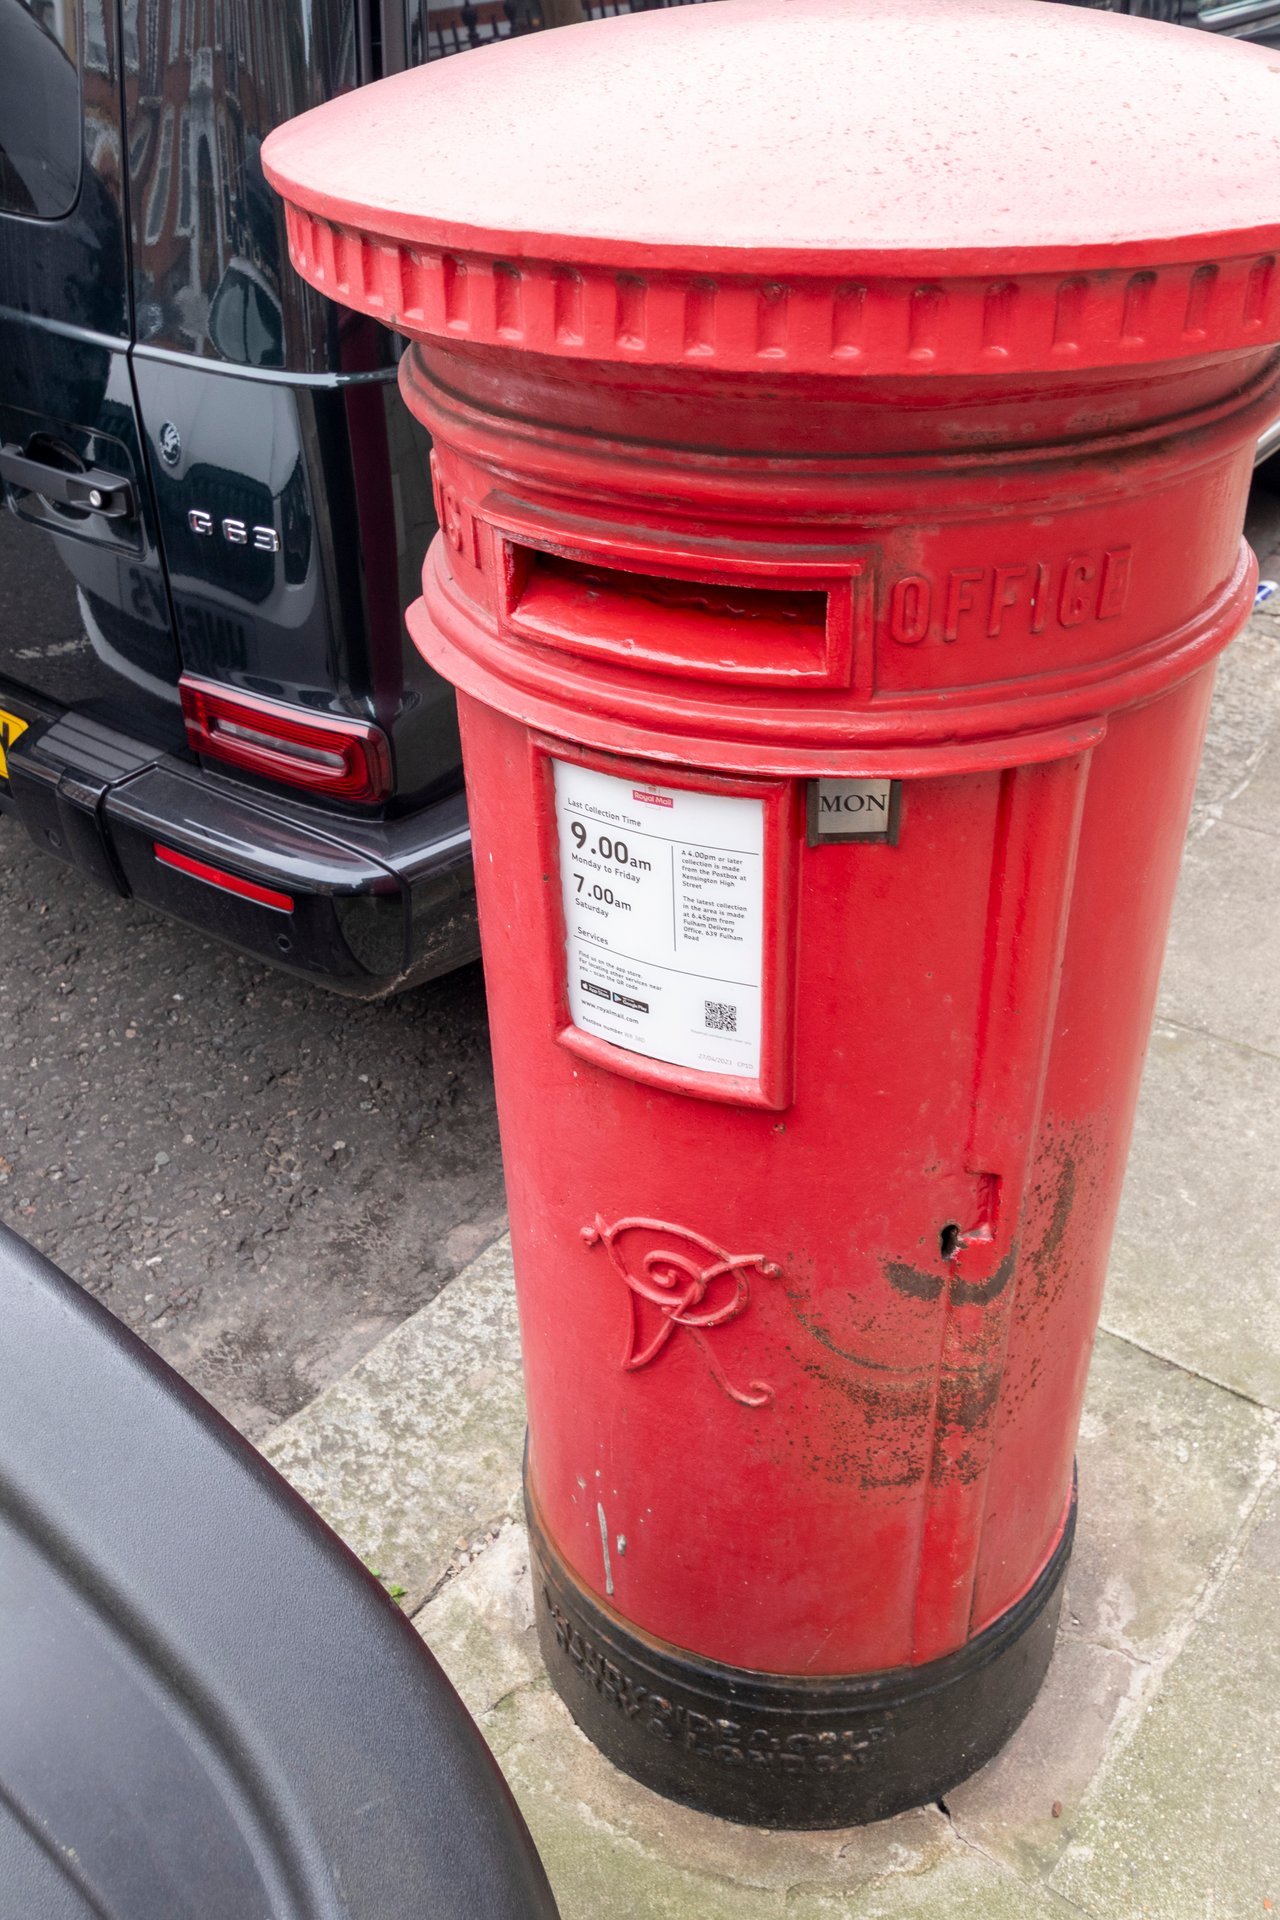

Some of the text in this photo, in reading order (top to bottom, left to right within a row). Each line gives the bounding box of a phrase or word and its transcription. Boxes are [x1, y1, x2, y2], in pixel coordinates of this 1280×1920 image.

[188, 509, 279, 552] G 63
[889, 542, 1133, 645] OFFICE
[634, 791, 672, 806] Royal Mail
[819, 793, 888, 813] MON
[568, 797, 641, 827] Last Collection Time
[571, 821, 652, 872] 9.00am
[682, 858, 712, 868] collection
[688, 851, 716, 861] 4.00pm
[727, 857, 743, 865] later
[571, 852, 641, 884] Monday to Friday
[682, 865, 698, 873] from
[712, 871, 737, 880] Postbox
[682, 873, 717, 884] Kensington
[682, 881, 702, 889] Street
[573, 873, 632, 911] 7.00am
[575, 898, 609, 918] Saturday
[717, 902, 747, 911] collection
[683, 918, 734, 933] Fulham Delivery
[692, 913, 718, 922] 6.45pm
[578, 926, 609, 945] Services
[719, 932, 743, 941] Fulham
[579, 950, 589, 959] Find
[606, 961, 614, 969] the
[616, 966, 626, 974] app
[588, 961, 609, 974] locating
[610, 970, 624, 979] other
[625, 975, 648, 987] services
[606, 975, 615, 983] the
[626, 983, 638, 991] code
[581, 1000, 639, 1024] www.royalmail.com
